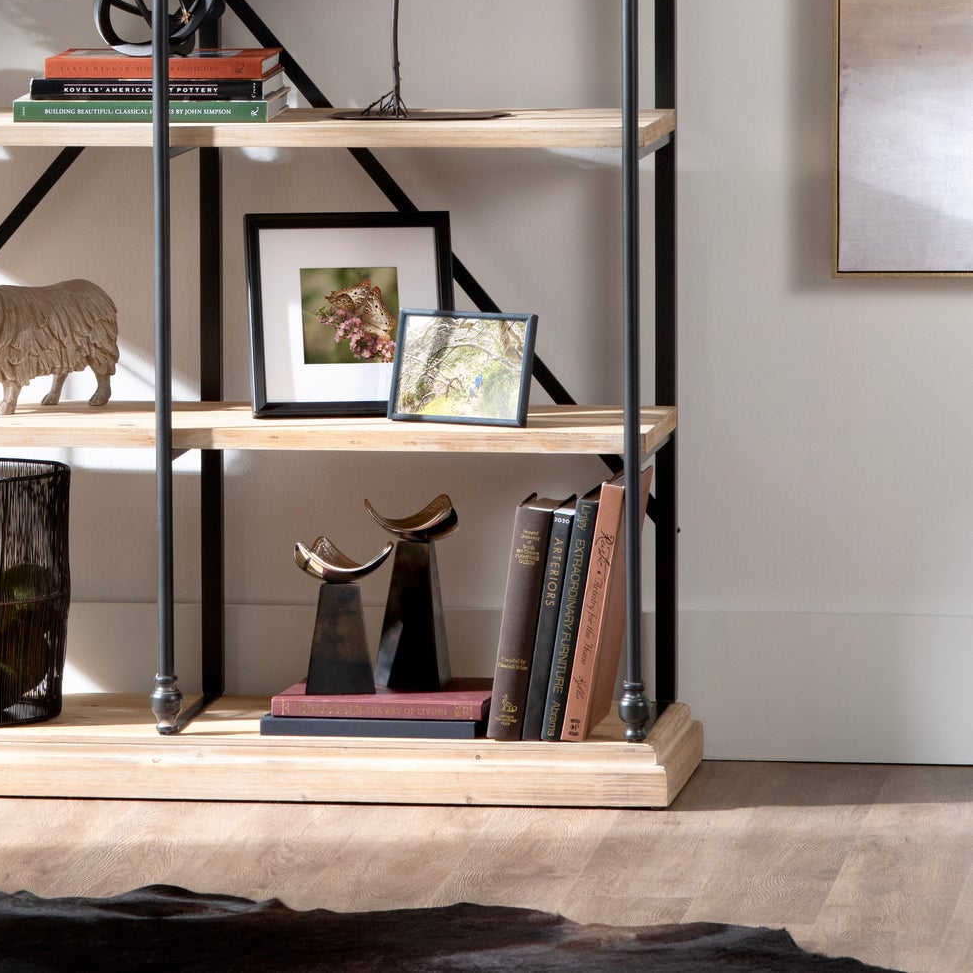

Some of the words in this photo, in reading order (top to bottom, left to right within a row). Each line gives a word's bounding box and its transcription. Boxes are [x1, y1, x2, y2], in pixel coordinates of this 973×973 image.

[554, 517, 571, 525] 2020
[545, 537, 563, 607] ARTERIORS
[563, 538, 586, 631] EXTRAORDINARY
[587, 578, 604, 612] Artistry
[553, 631, 571, 694] FURNITURE
[580, 641, 593, 666] Home
[547, 701, 561, 737] Abrams
